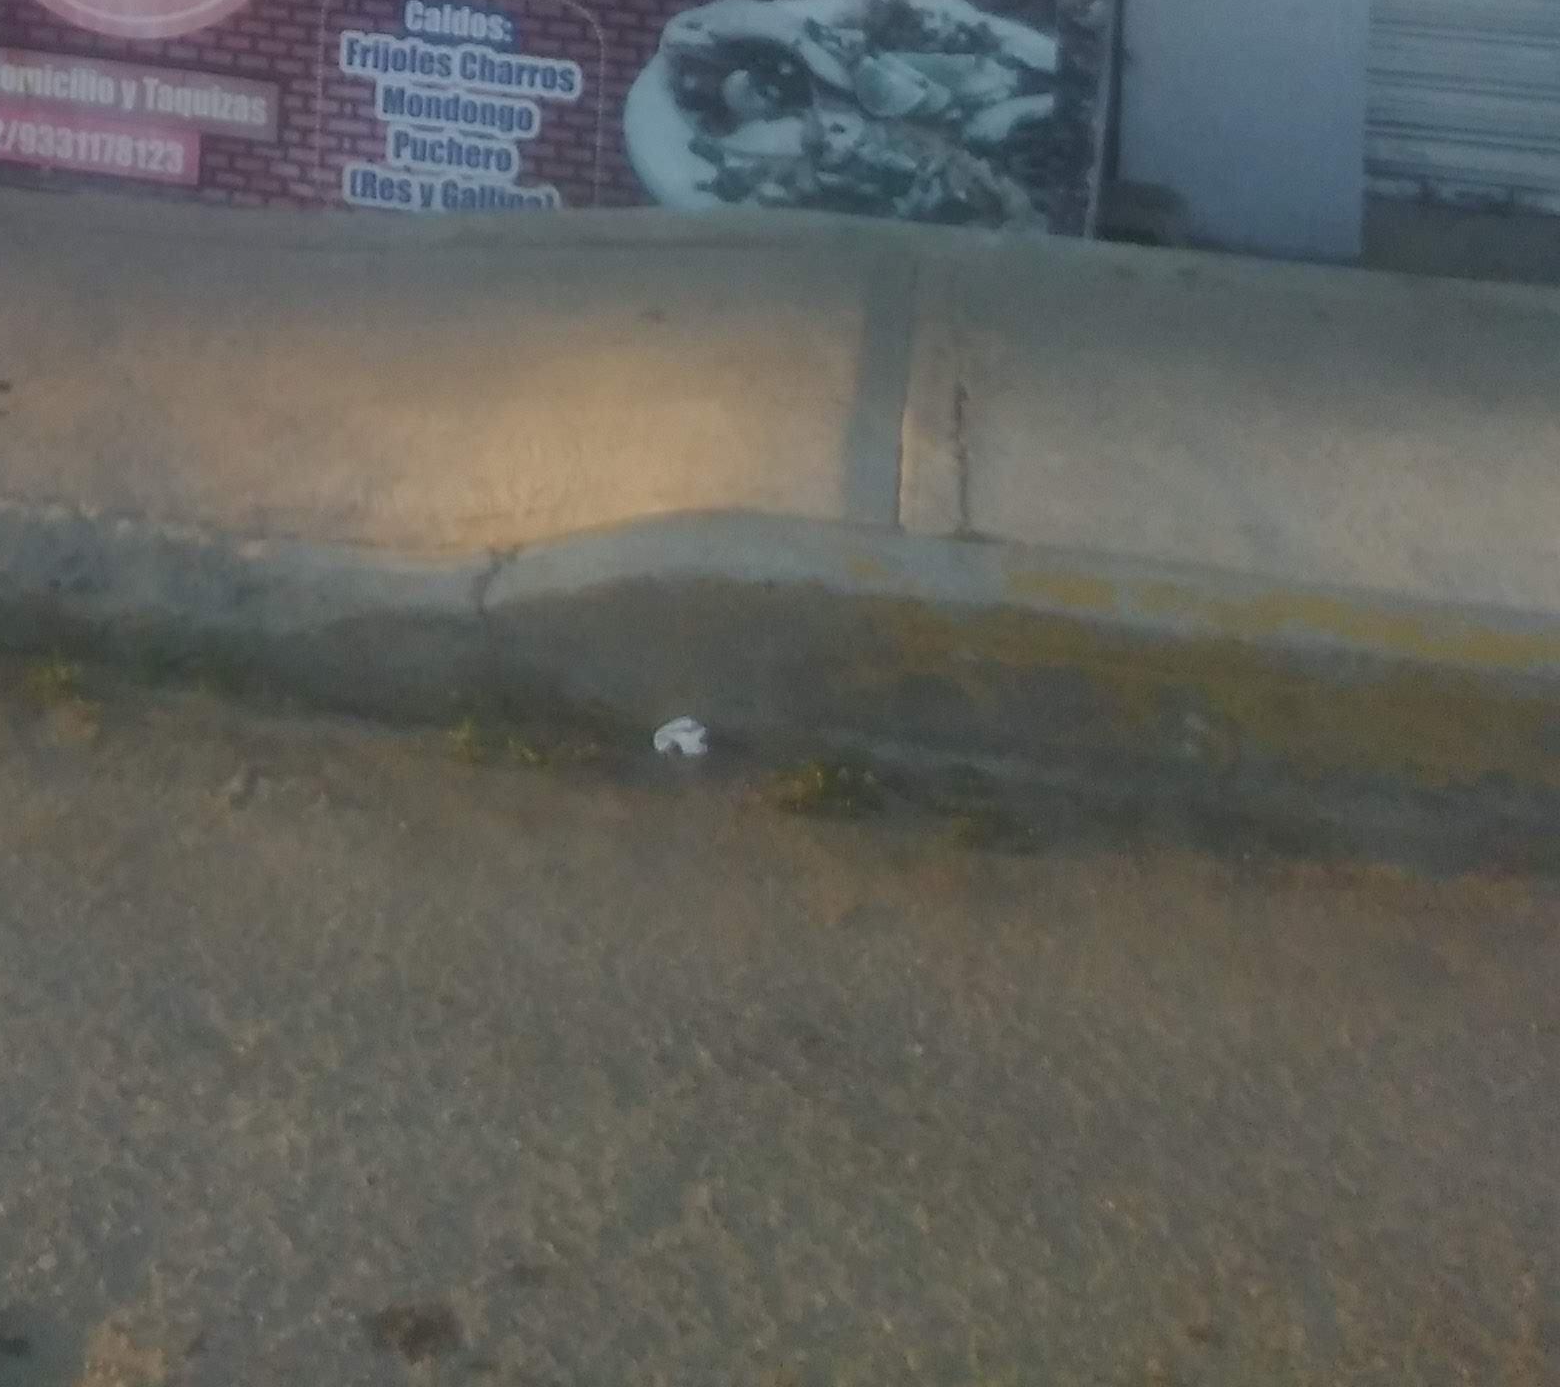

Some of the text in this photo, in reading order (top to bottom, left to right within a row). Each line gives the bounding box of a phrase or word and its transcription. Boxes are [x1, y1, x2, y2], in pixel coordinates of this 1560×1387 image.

[346, 38, 576, 94] Frijoles Charros
[121, 78, 137, 111] y
[142, 76, 268, 125] Taquizas
[382, 86, 534, 132] Mondongo
[393, 130, 513, 173] Puchero
[419, 181, 435, 209] y
